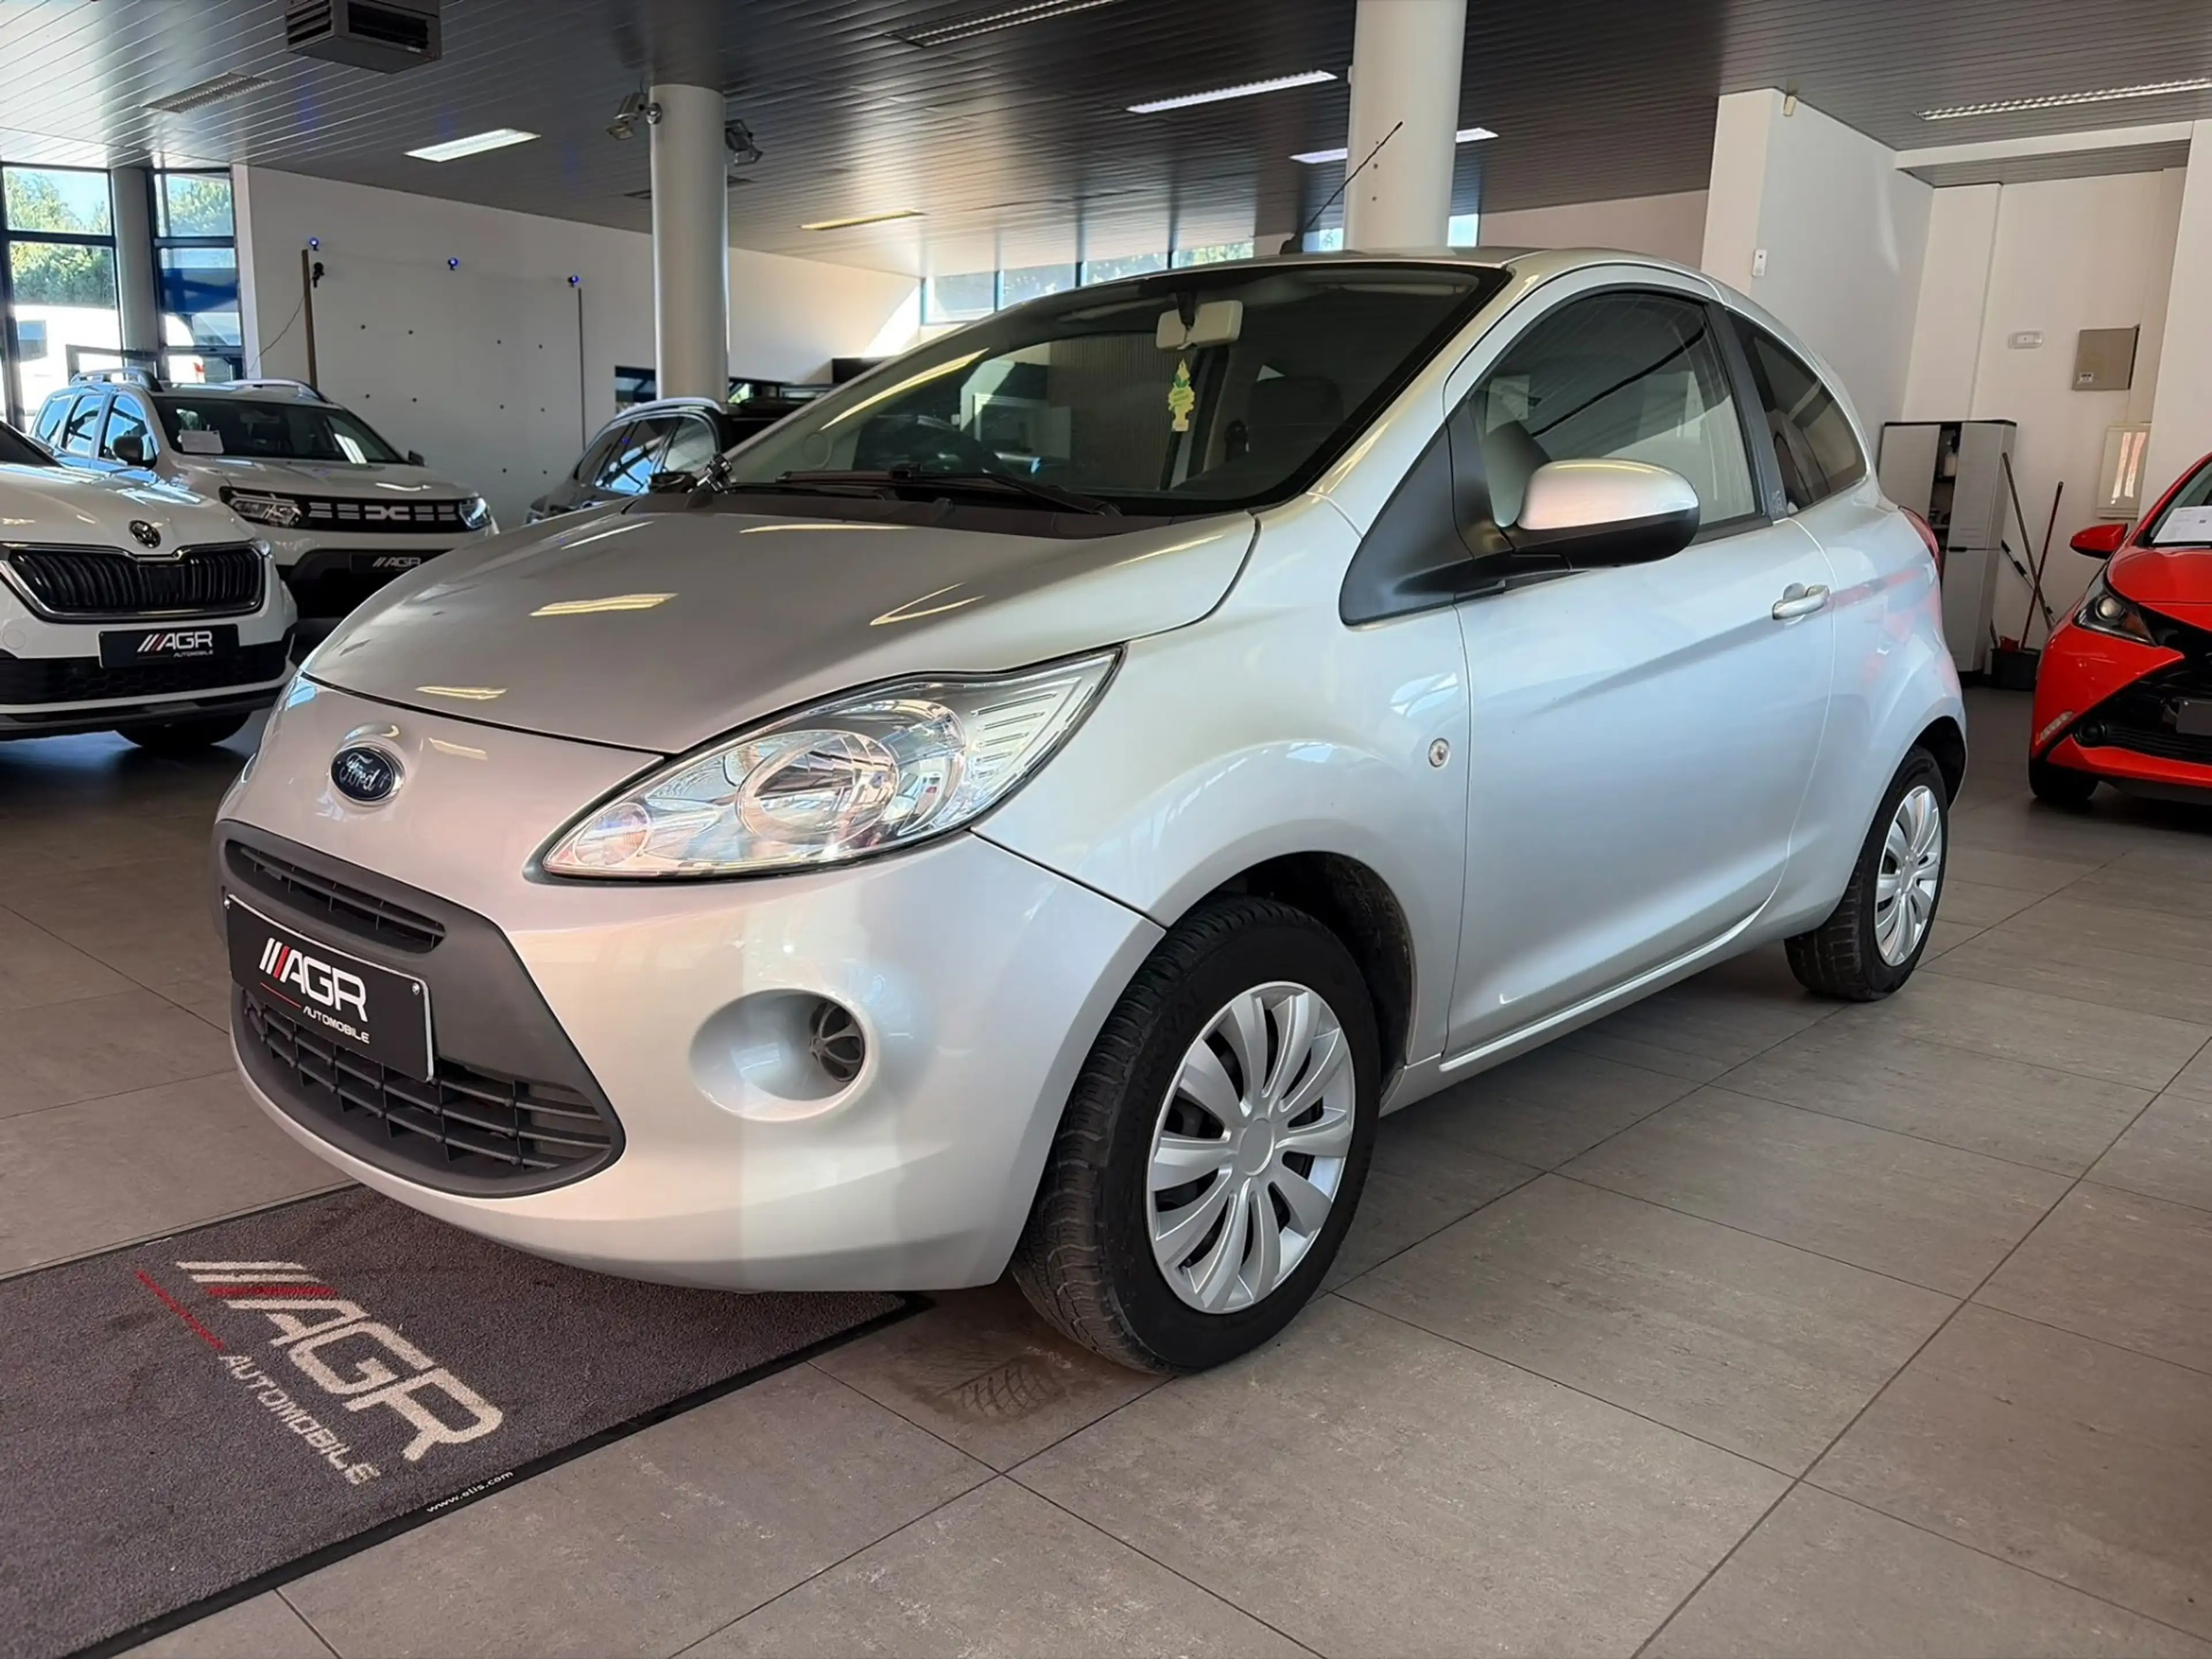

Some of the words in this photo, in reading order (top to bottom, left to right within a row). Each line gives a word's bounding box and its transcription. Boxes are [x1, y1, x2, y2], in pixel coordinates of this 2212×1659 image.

[156, 630, 213, 652] AGR
[280, 949, 369, 1022] AGR
[303, 1005, 370, 1044] AUTOMOBILE
[226, 1299, 503, 1462] AGR
[218, 1354, 381, 1486] AUTOMOBILE
[426, 1471, 514, 1513] www.elis.com
